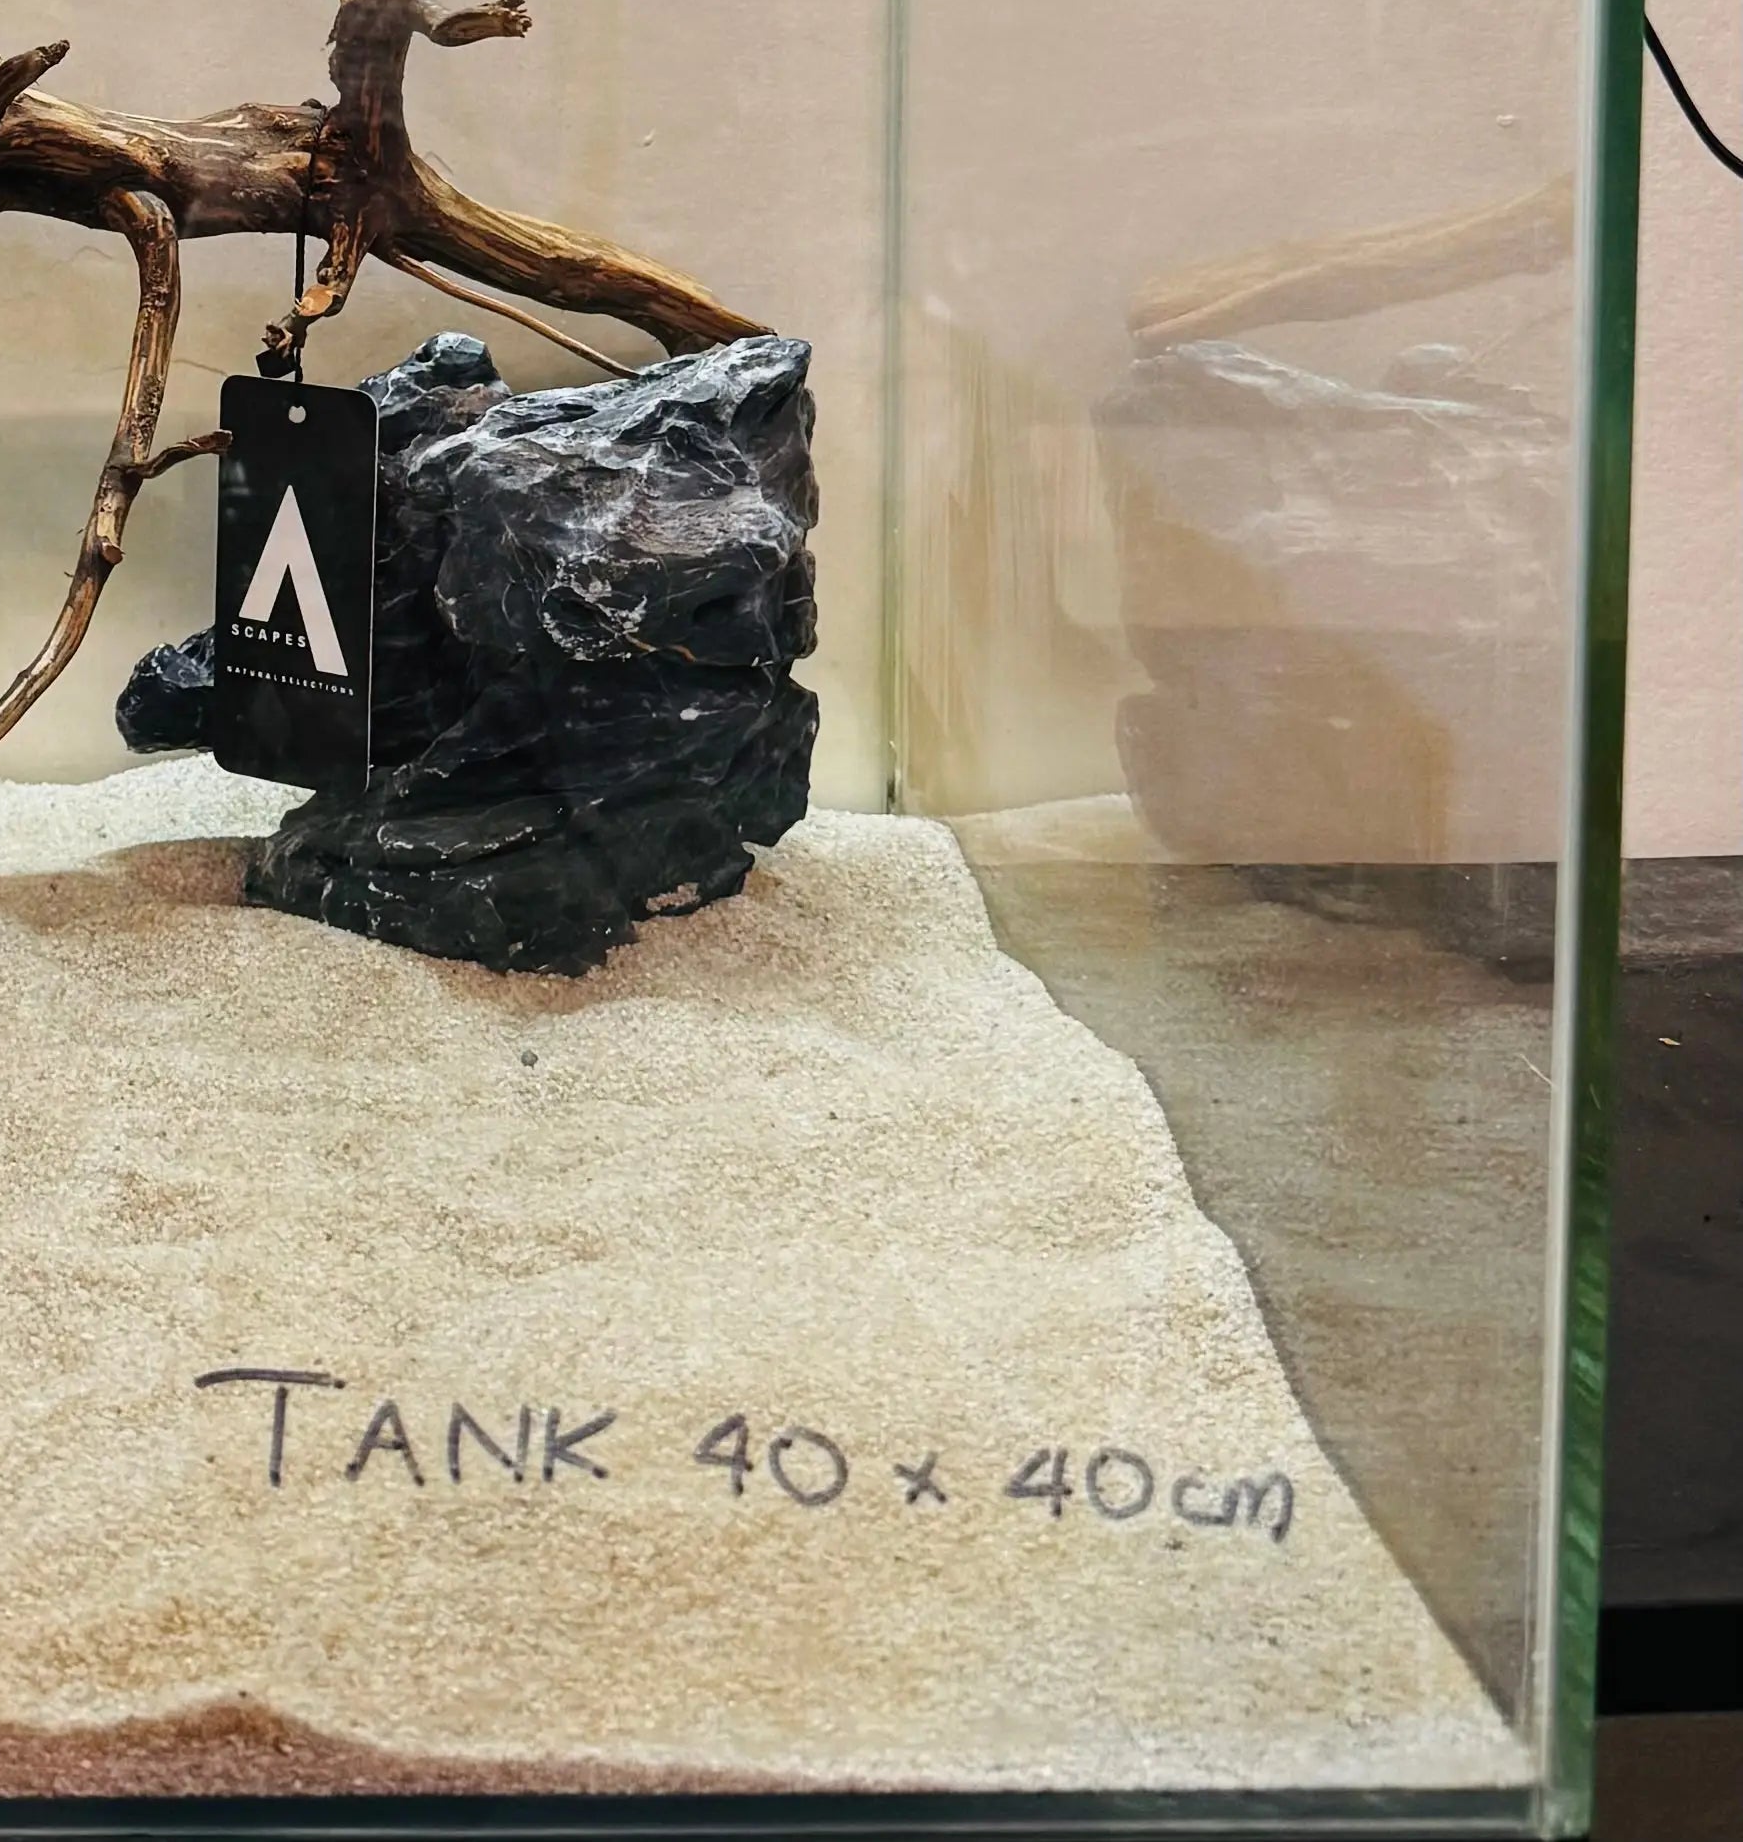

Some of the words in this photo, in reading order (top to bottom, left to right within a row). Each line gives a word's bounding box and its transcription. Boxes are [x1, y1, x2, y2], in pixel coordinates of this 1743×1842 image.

[231, 623, 307, 648] SCAPES
[194, 1367, 618, 1489] TANK
[693, 1413, 849, 1507] 40
